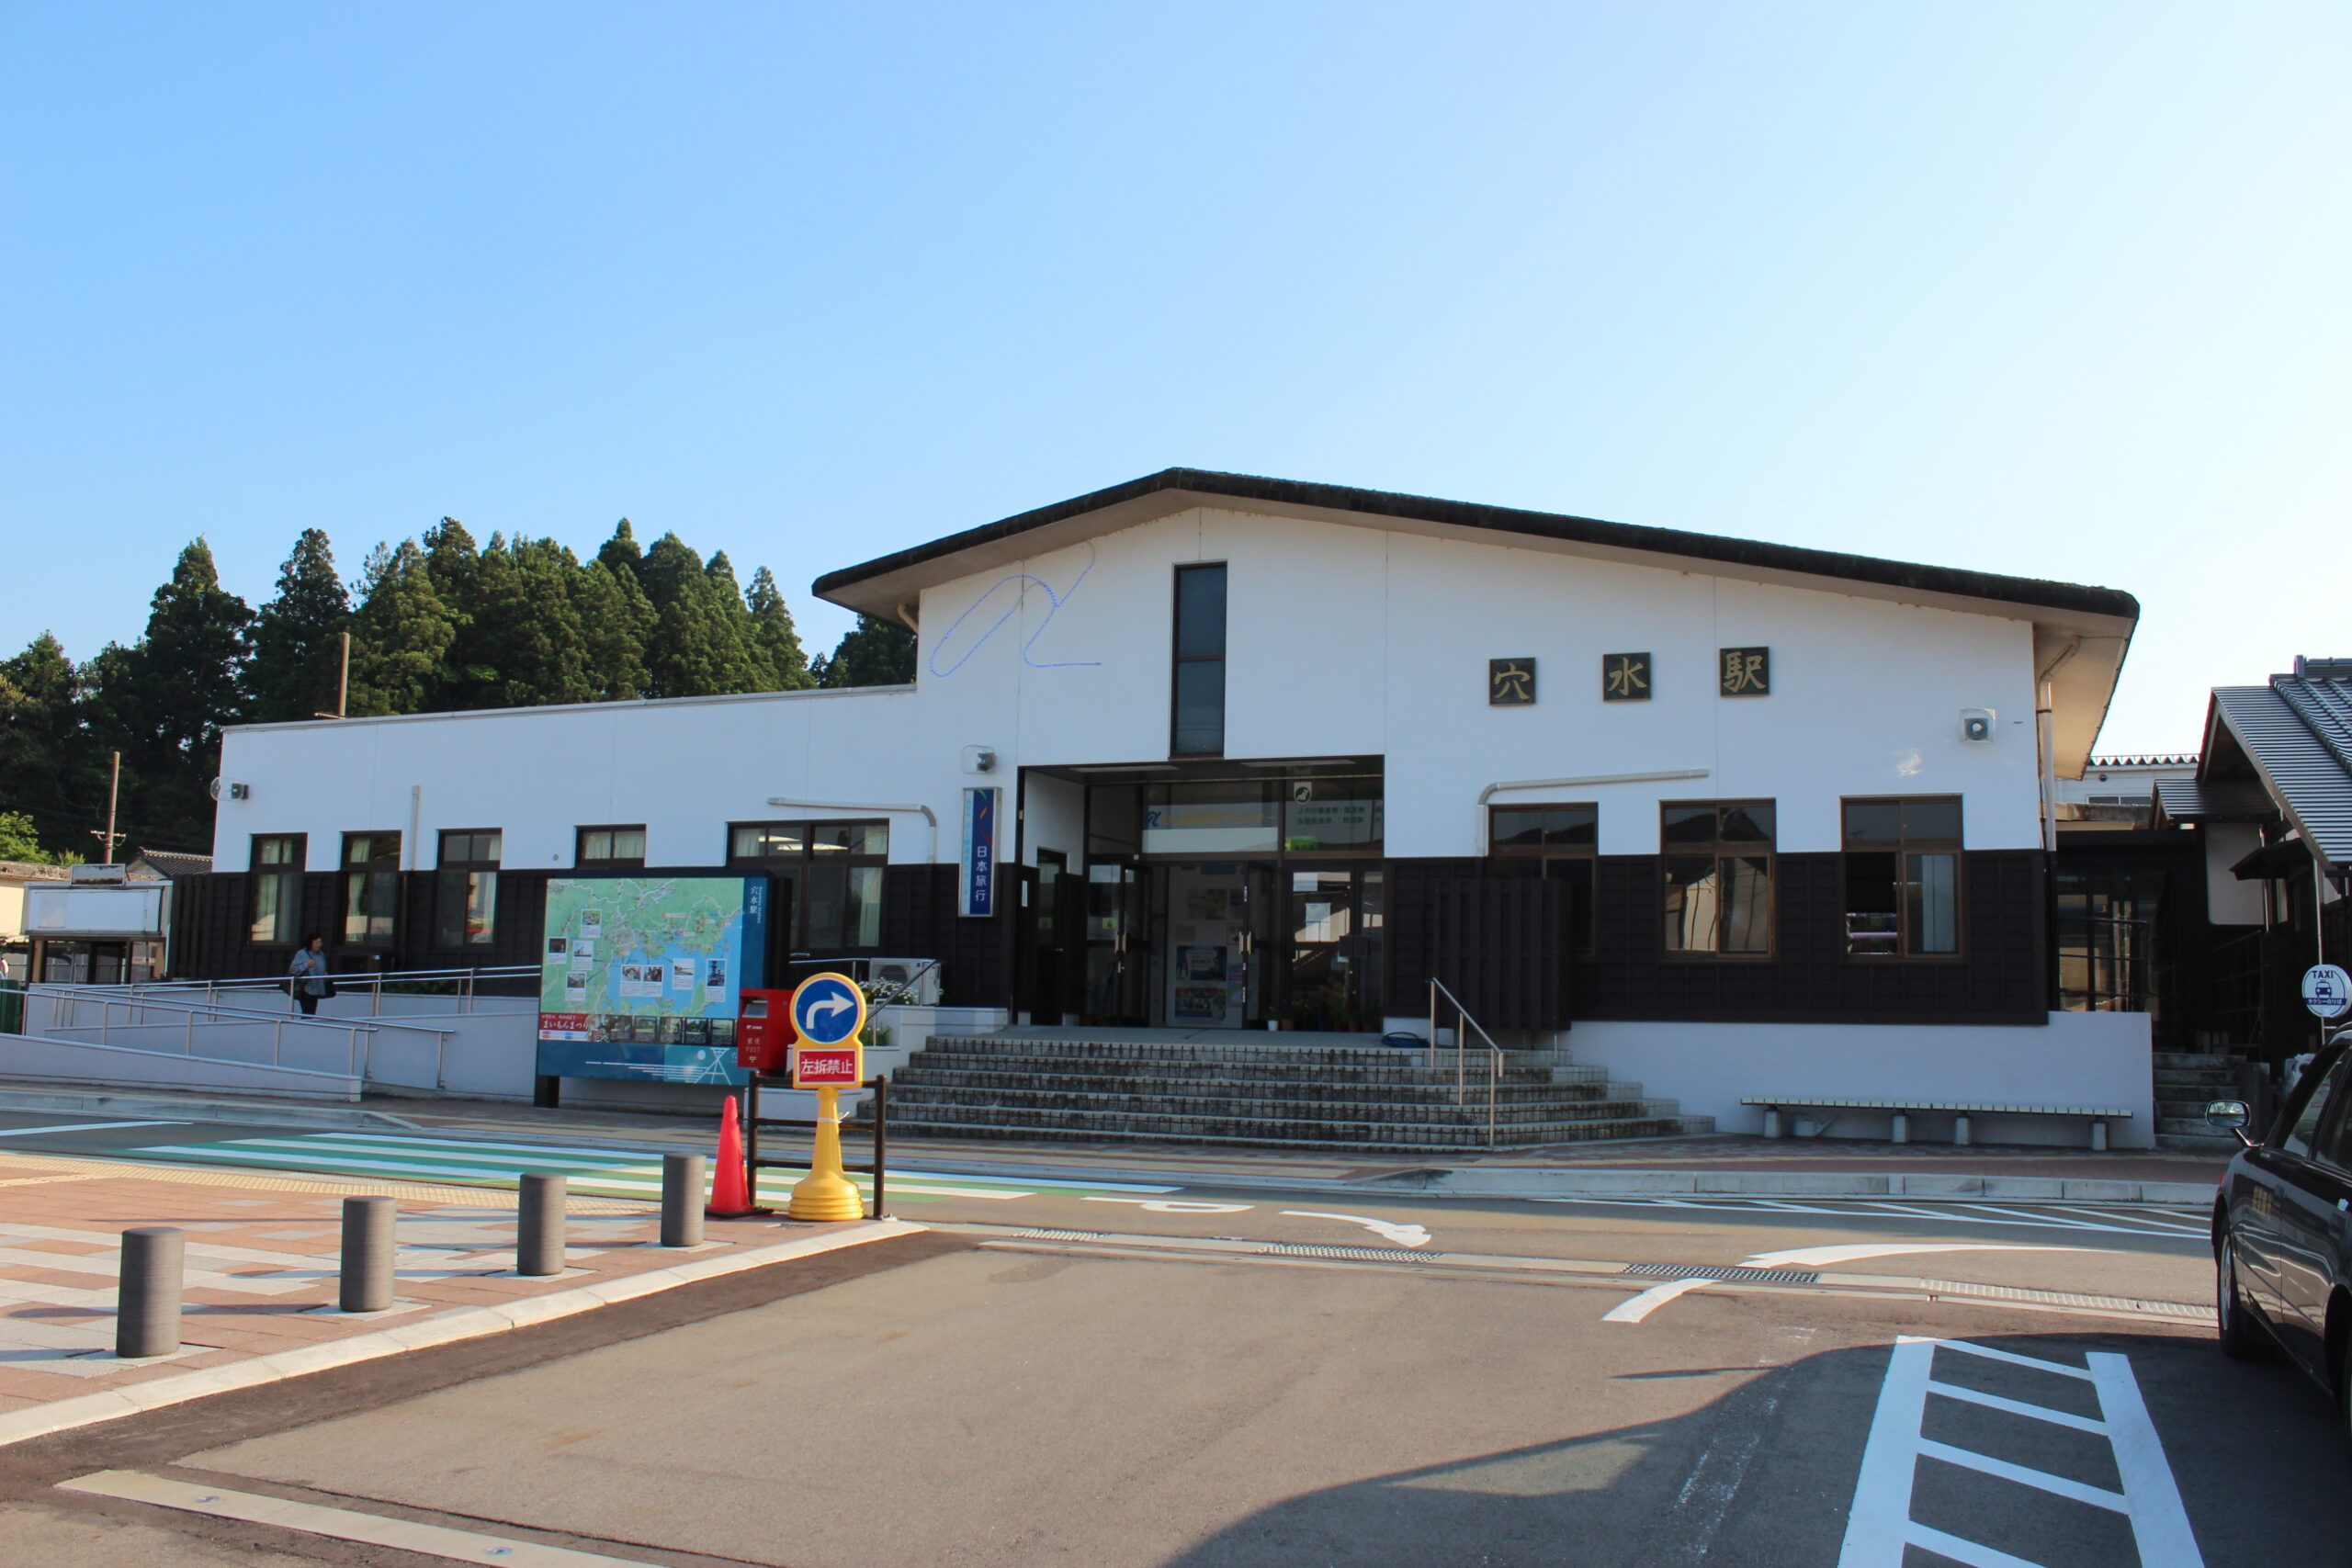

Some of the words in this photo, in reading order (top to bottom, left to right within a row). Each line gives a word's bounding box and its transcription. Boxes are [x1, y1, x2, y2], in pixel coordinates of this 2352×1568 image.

[1494, 651, 1767, 700] 穴水駅
[975, 845, 988, 902] 日本旅行
[2312, 970, 2334, 979] TAXI
[543, 1020, 588, 1030] まいもんまつり
[800, 1058, 854, 1075] 左折禁止
